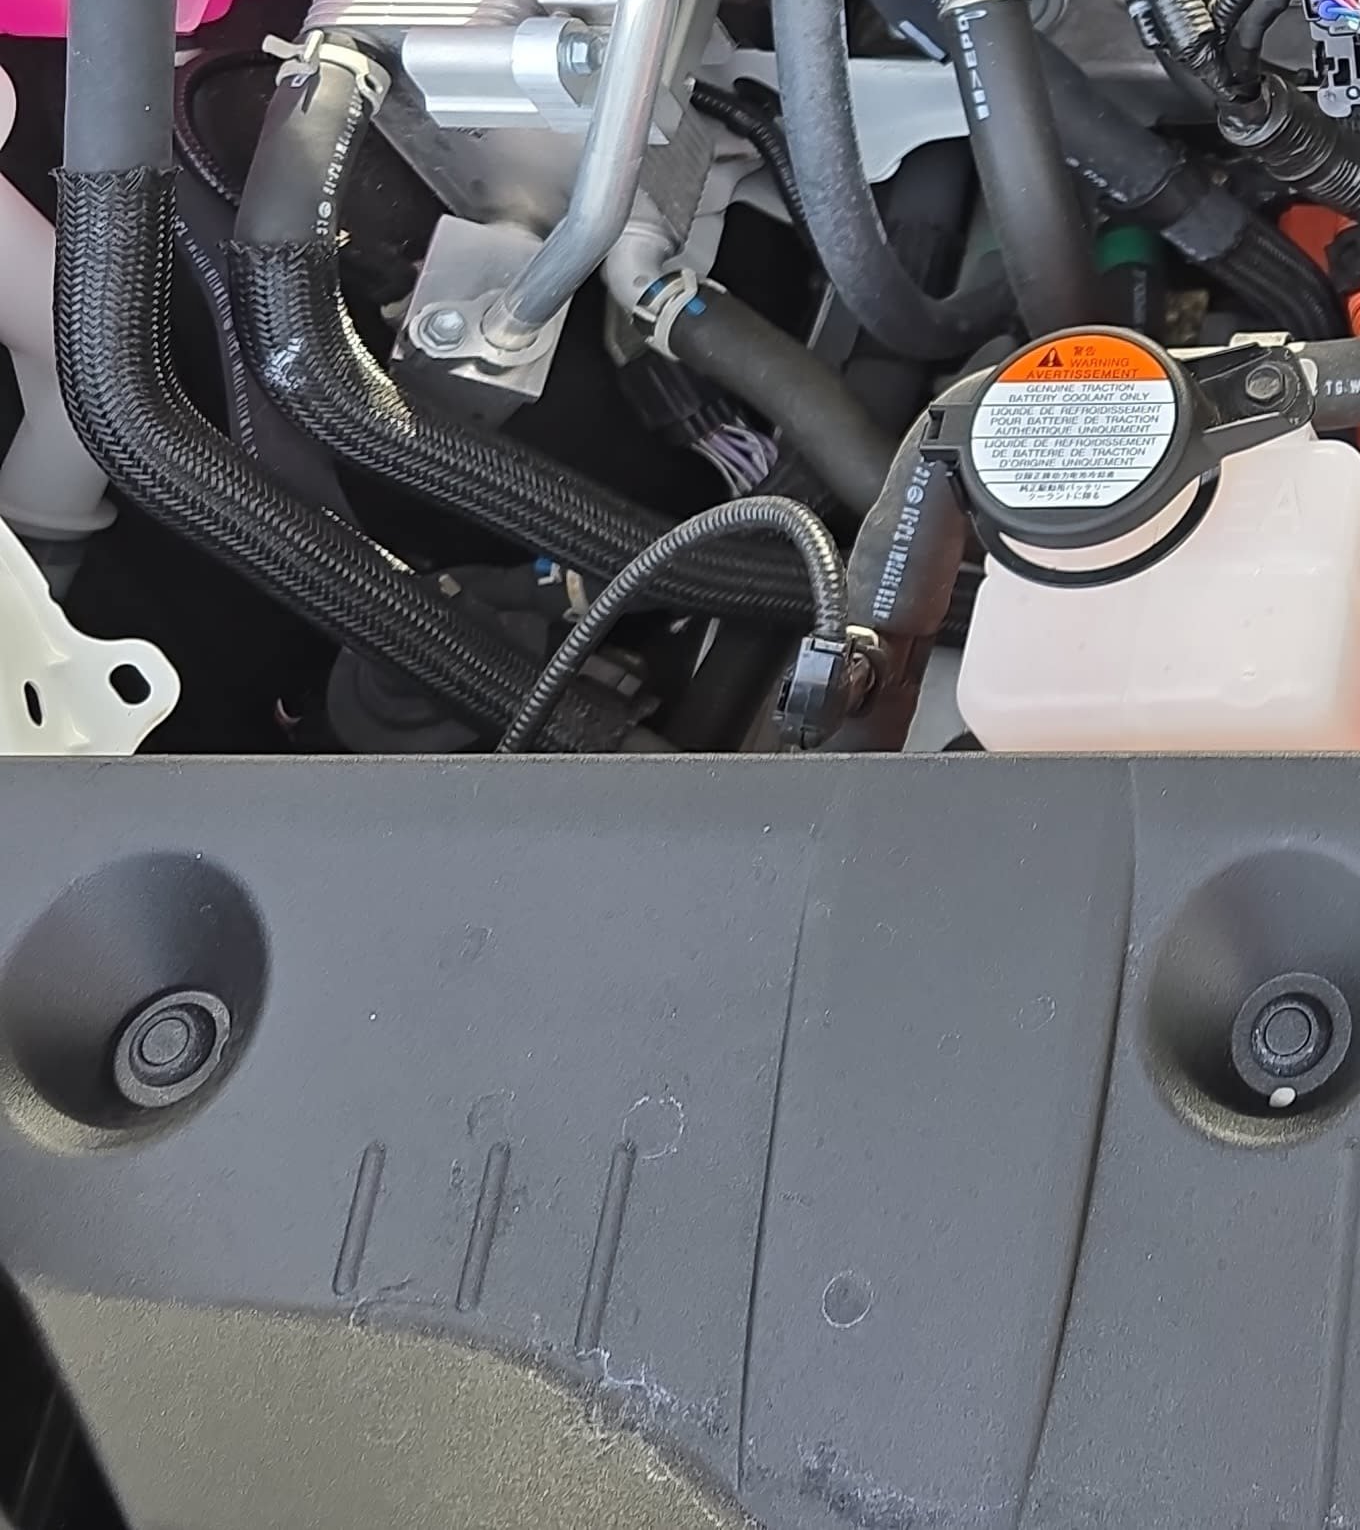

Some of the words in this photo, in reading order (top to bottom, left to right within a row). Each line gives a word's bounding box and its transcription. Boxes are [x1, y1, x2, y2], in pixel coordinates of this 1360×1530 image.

[1070, 358, 1130, 368] WARNING
[1026, 368, 1139, 379] AVERTISSEMENT
[1026, 384, 1074, 393] GENUINE
[1081, 383, 1135, 392] TRACTION
[1009, 394, 1056, 403] BATTERY
[1062, 393, 1114, 402] COOLANT
[1120, 393, 1149, 401] ONLY
[991, 407, 1034, 416] LIQUIDE
[1040, 407, 1055, 415] DE
[1060, 405, 1161, 416] REFROIDISSEMENT
[990, 416, 1022, 426] POUR
[1027, 416, 1078, 425] BATTERIE
[1084, 415, 1099, 424] DE
[1105, 415, 1159, 424] TRACTION
[995, 425, 1072, 435] AUTHENTIQUE
[1077, 425, 1151, 434] UNIQUEMENT
[985, 439, 1027, 448] LIQUIDE
[1033, 439, 1048, 448] DE
[1054, 438, 1156, 447] REFROIDISSEMENT
[992, 449, 1007, 458] DE
[1013, 449, 1064, 458] BATTERIE
[1070, 448, 1085, 457] DE
[1092, 447, 1146, 456] TRACTION
[1000, 459, 1056, 468] D'ORIGINE
[1061, 458, 1136, 467] UNIQUEMENT
